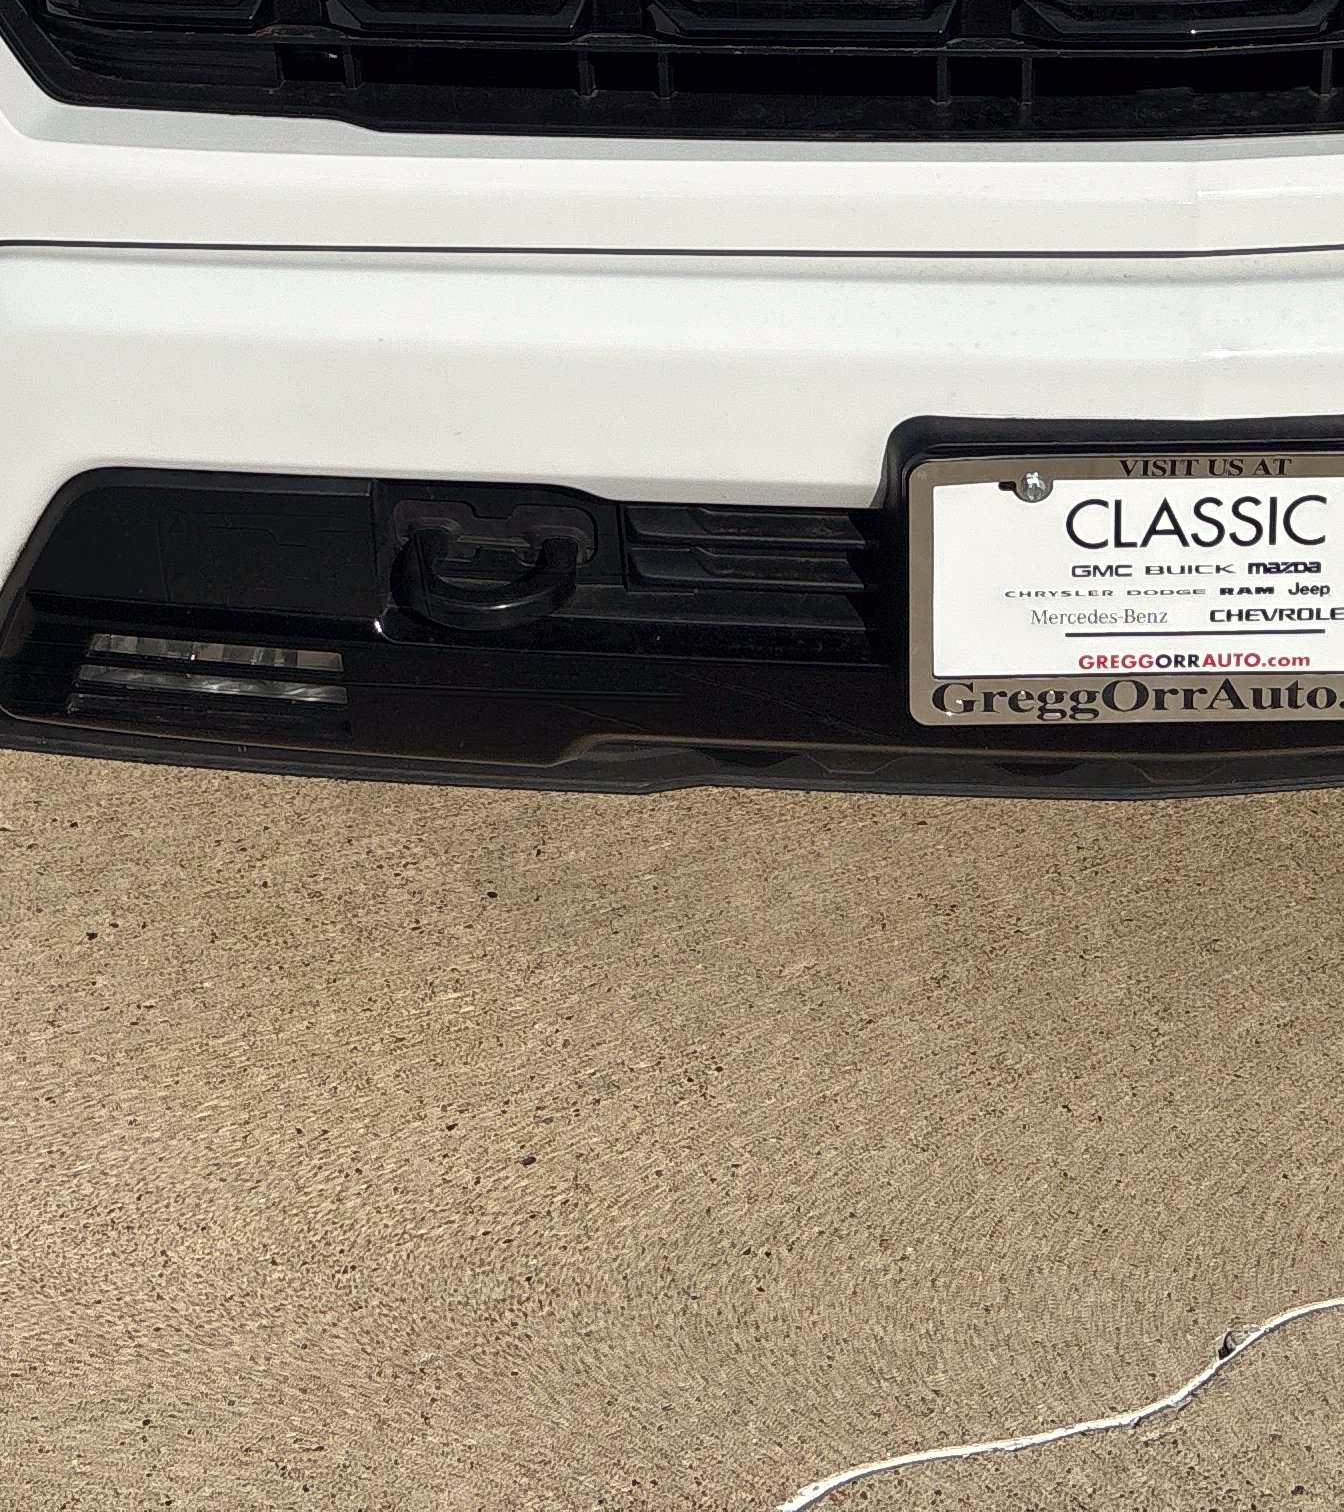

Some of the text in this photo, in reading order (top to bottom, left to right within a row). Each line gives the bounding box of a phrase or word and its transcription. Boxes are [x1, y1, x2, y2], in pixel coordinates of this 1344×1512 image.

[1118, 457, 1293, 478] VISIT US AT
[1065, 495, 1328, 550] CLASSIC
[1070, 563, 1133, 578] GMC
[1144, 563, 1237, 576] BUICK
[1004, 590, 1114, 598] CHRYSLER
[1126, 588, 1206, 596] DODGE
[1219, 586, 1275, 595] RAM
[1287, 582, 1331, 598] Jeep
[1030, 608, 1169, 625] Mercedes-Benz
[1077, 652, 1312, 671] GREGGORRAUTO.com
